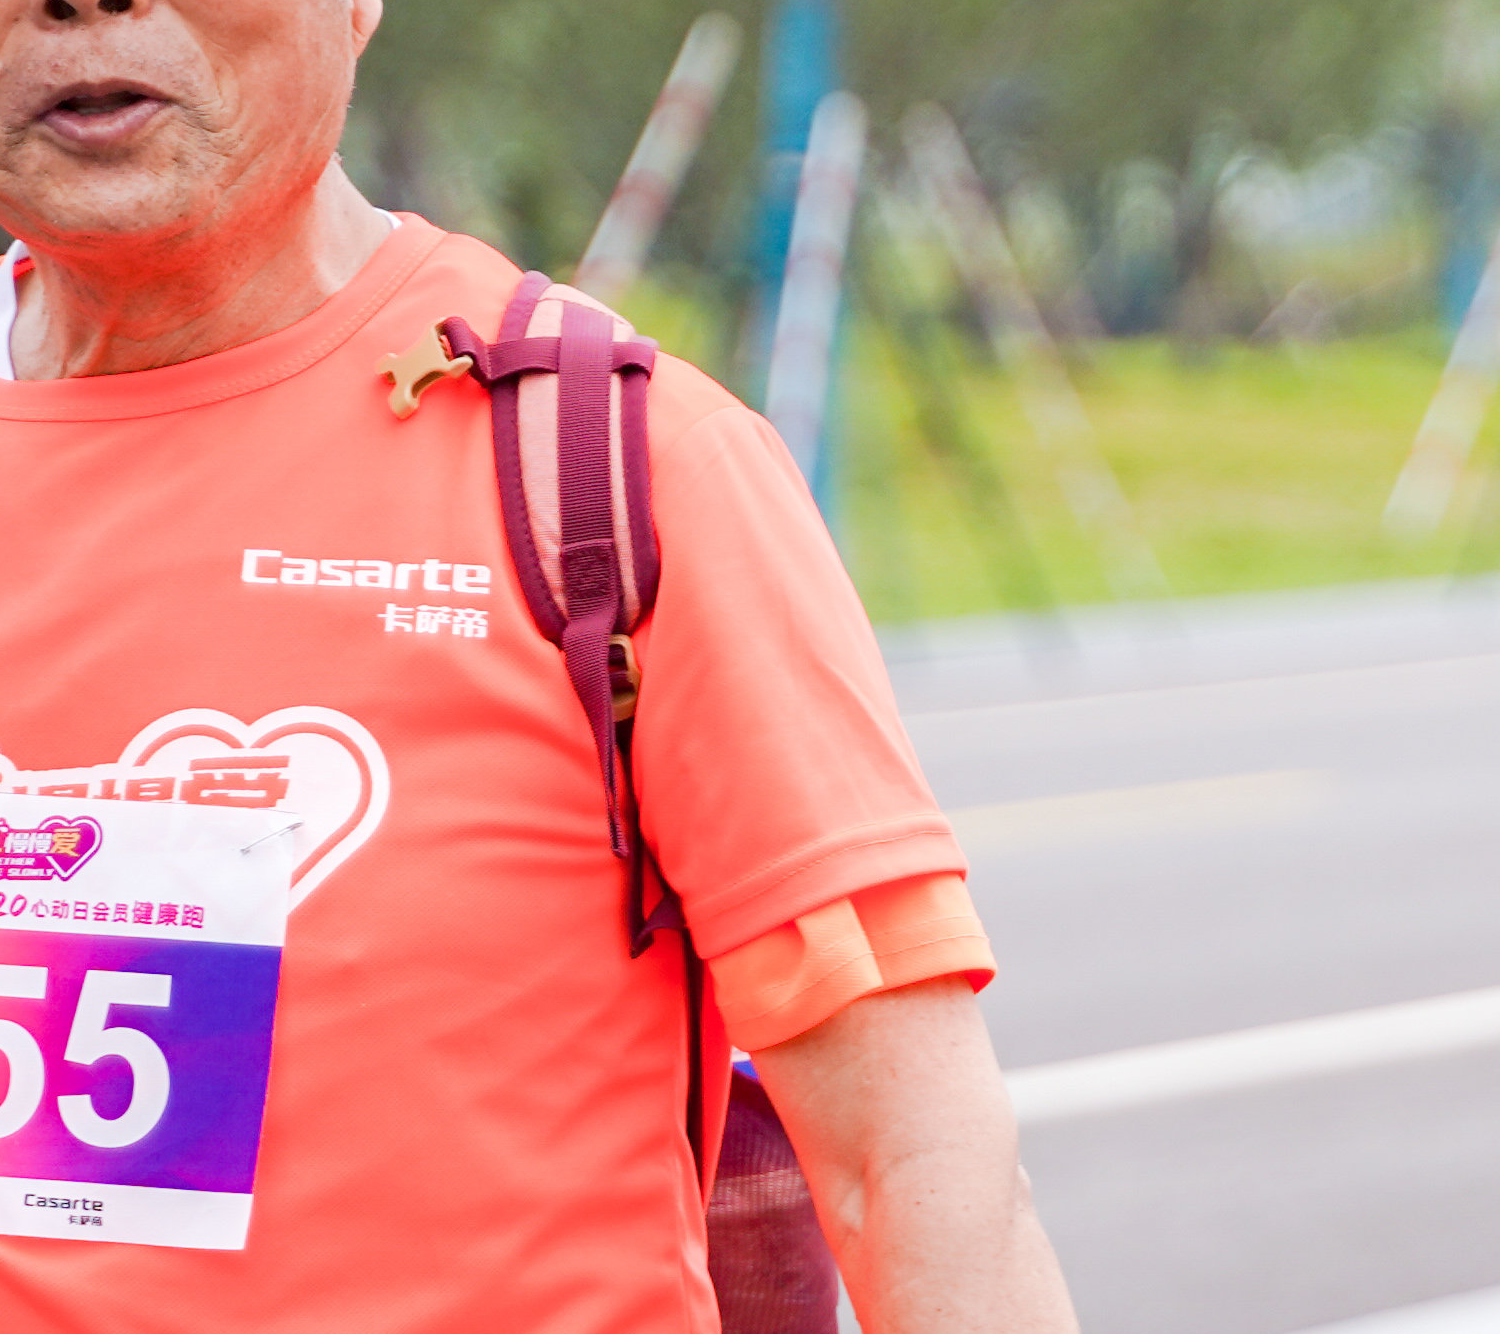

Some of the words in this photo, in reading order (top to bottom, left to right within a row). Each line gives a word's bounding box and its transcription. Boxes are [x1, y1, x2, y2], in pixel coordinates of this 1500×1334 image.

[241, 548, 491, 595] Casarte
[377, 603, 489, 638] 卡萨帝
[7, 868, 54, 878] SLOWLY
[24, 1193, 104, 1212] Casarte
